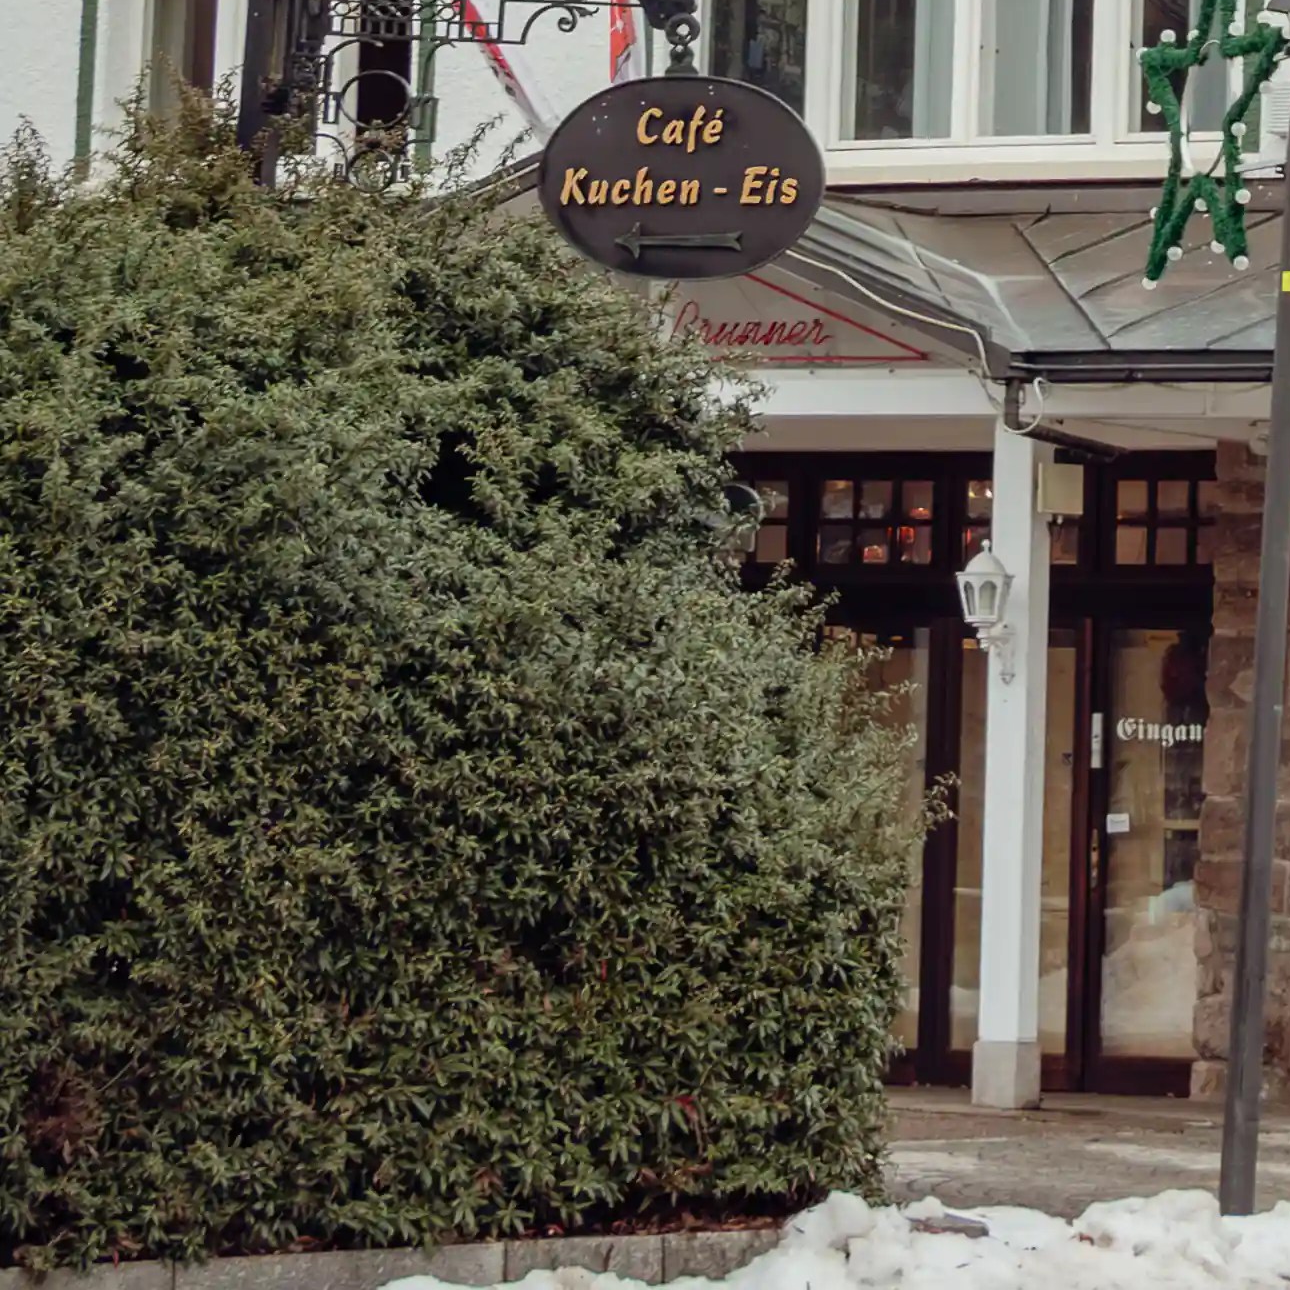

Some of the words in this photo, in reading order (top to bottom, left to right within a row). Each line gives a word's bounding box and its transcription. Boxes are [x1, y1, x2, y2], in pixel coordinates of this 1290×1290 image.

[636, 105, 724, 154] Café
[560, 166, 701, 206] Kuchen
[740, 165, 799, 206] Eis
